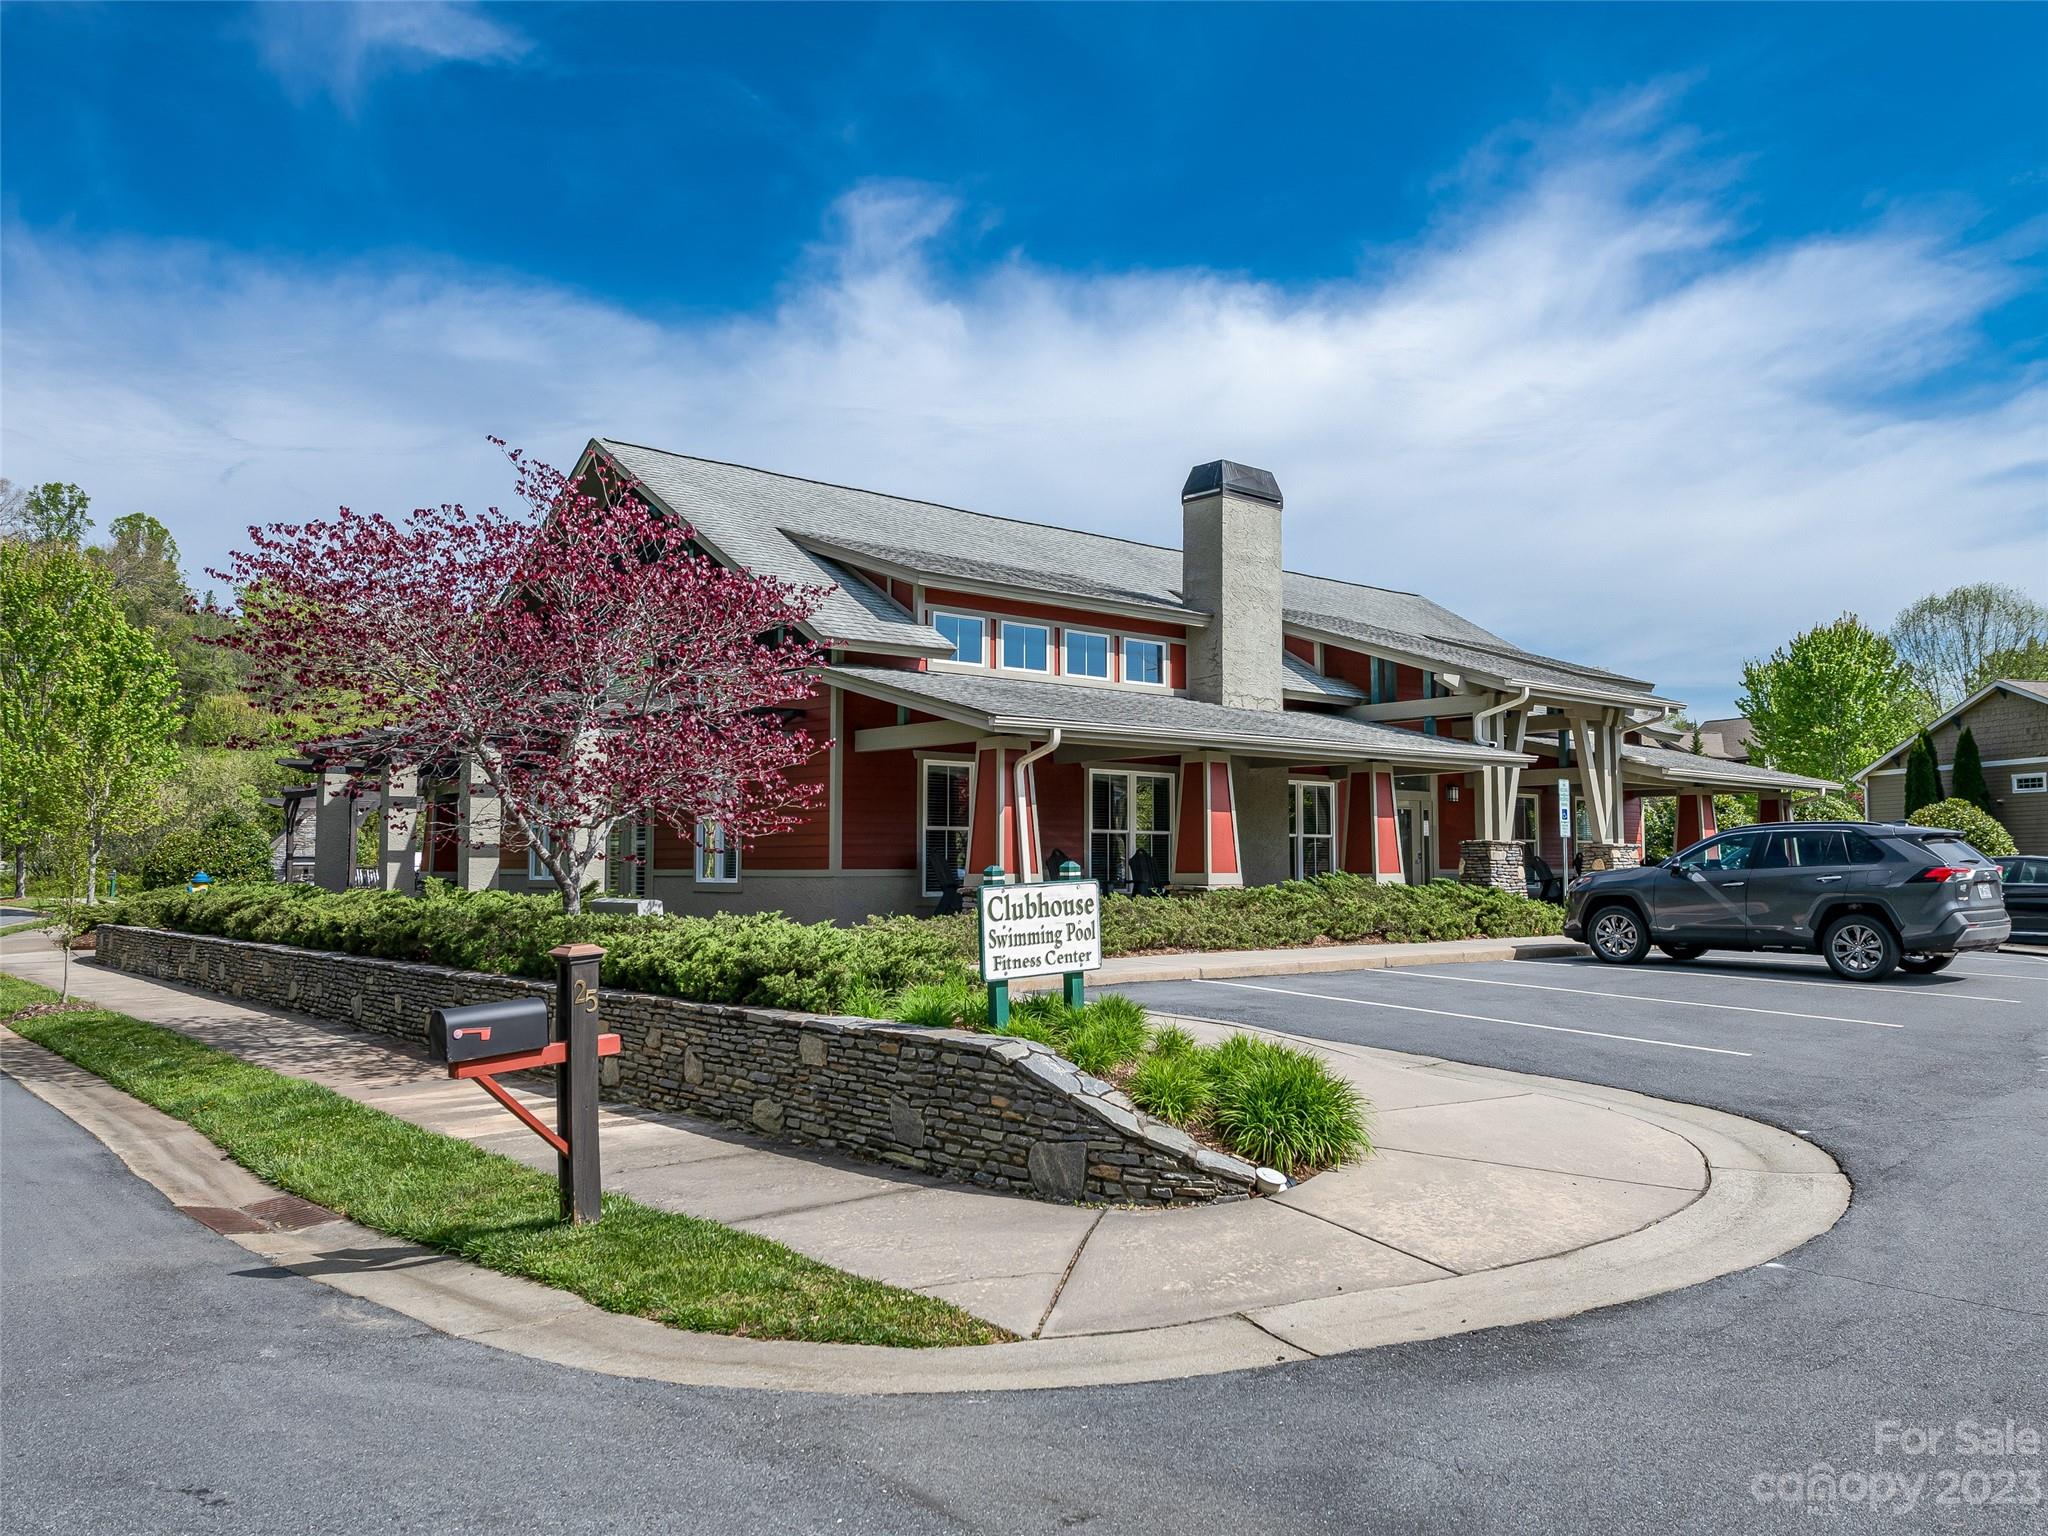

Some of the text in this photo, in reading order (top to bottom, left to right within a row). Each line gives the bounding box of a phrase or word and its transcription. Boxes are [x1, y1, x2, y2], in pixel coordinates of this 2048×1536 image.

[987, 892, 1095, 922] Clubhouse
[988, 921, 1096, 949] Swimming Pool
[993, 950, 1092, 971] Fitness Center
[574, 980, 599, 1013] 25
